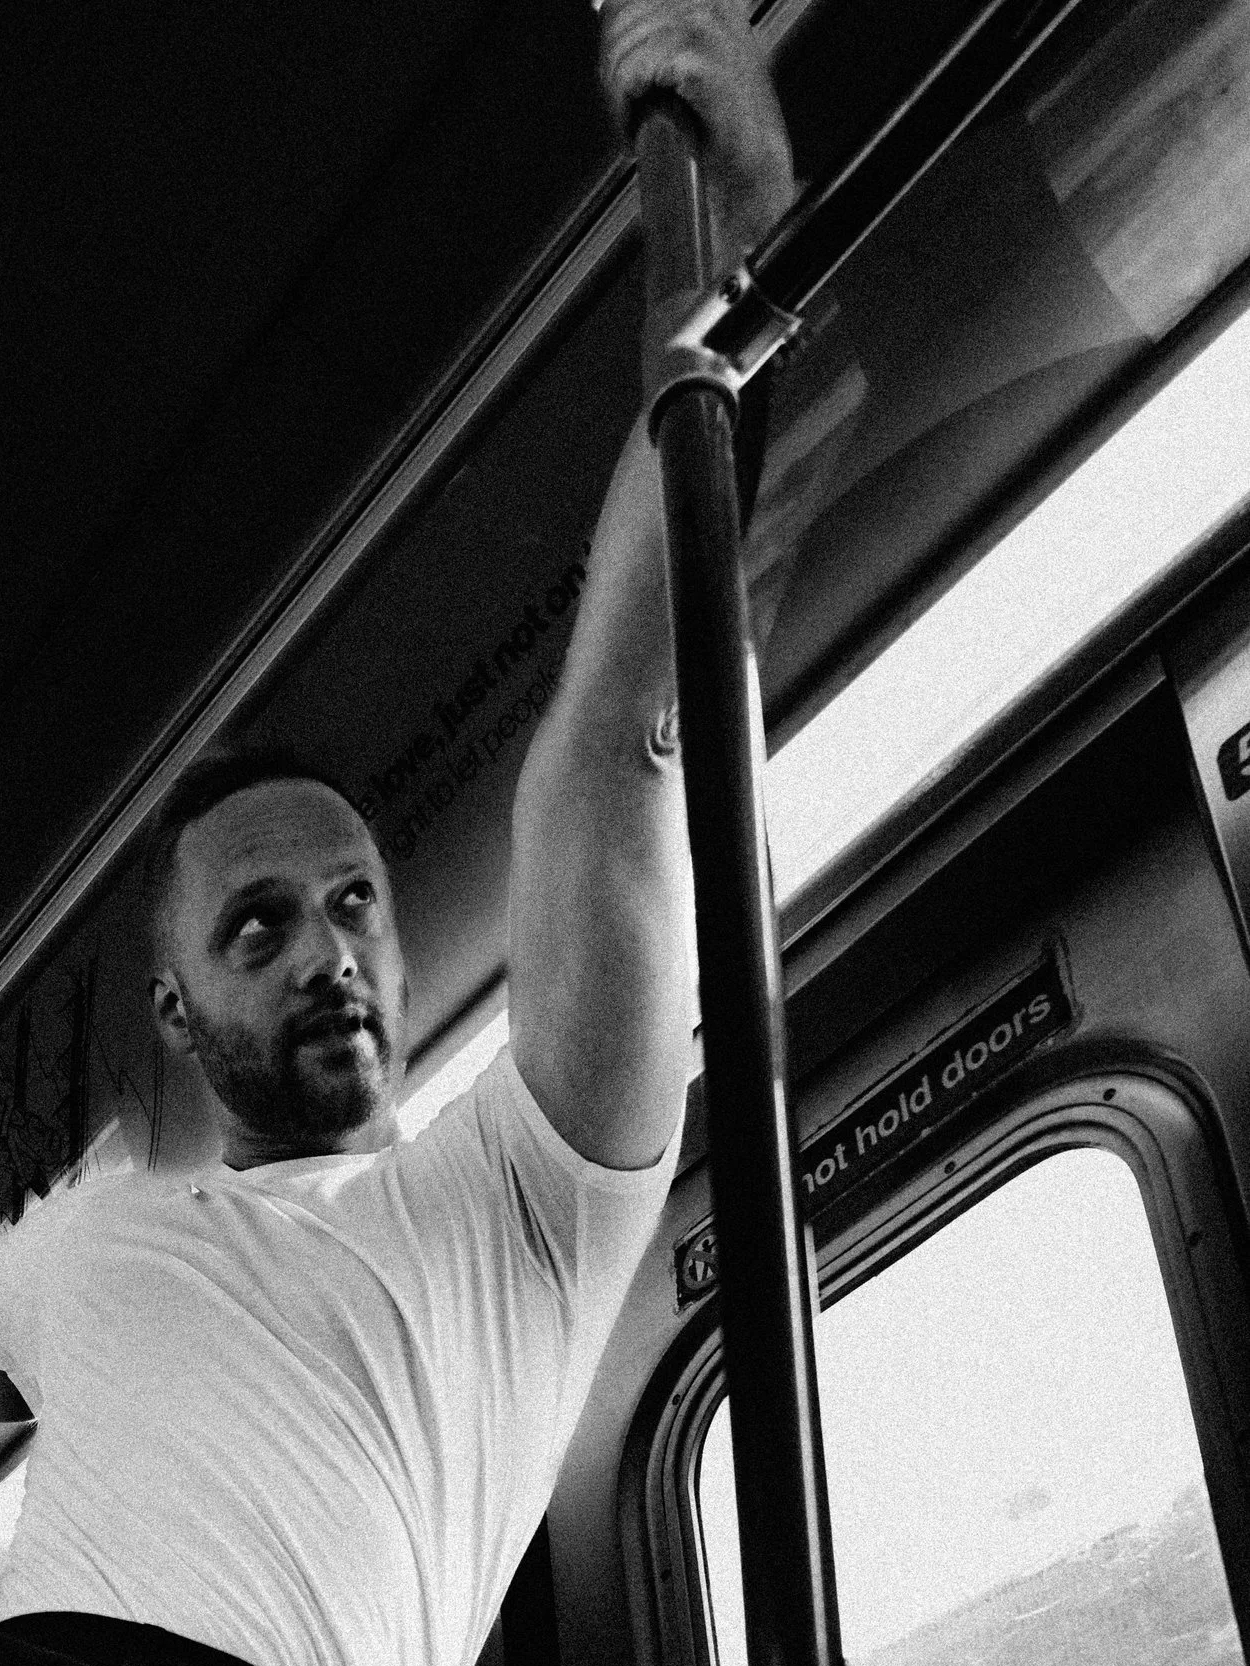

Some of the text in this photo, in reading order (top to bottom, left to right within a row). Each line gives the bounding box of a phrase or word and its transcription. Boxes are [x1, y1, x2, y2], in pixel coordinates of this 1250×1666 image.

[434, 661, 497, 736] just
[496, 605, 549, 675] not
[854, 1075, 933, 1156] hold
[940, 993, 1052, 1088] doors
